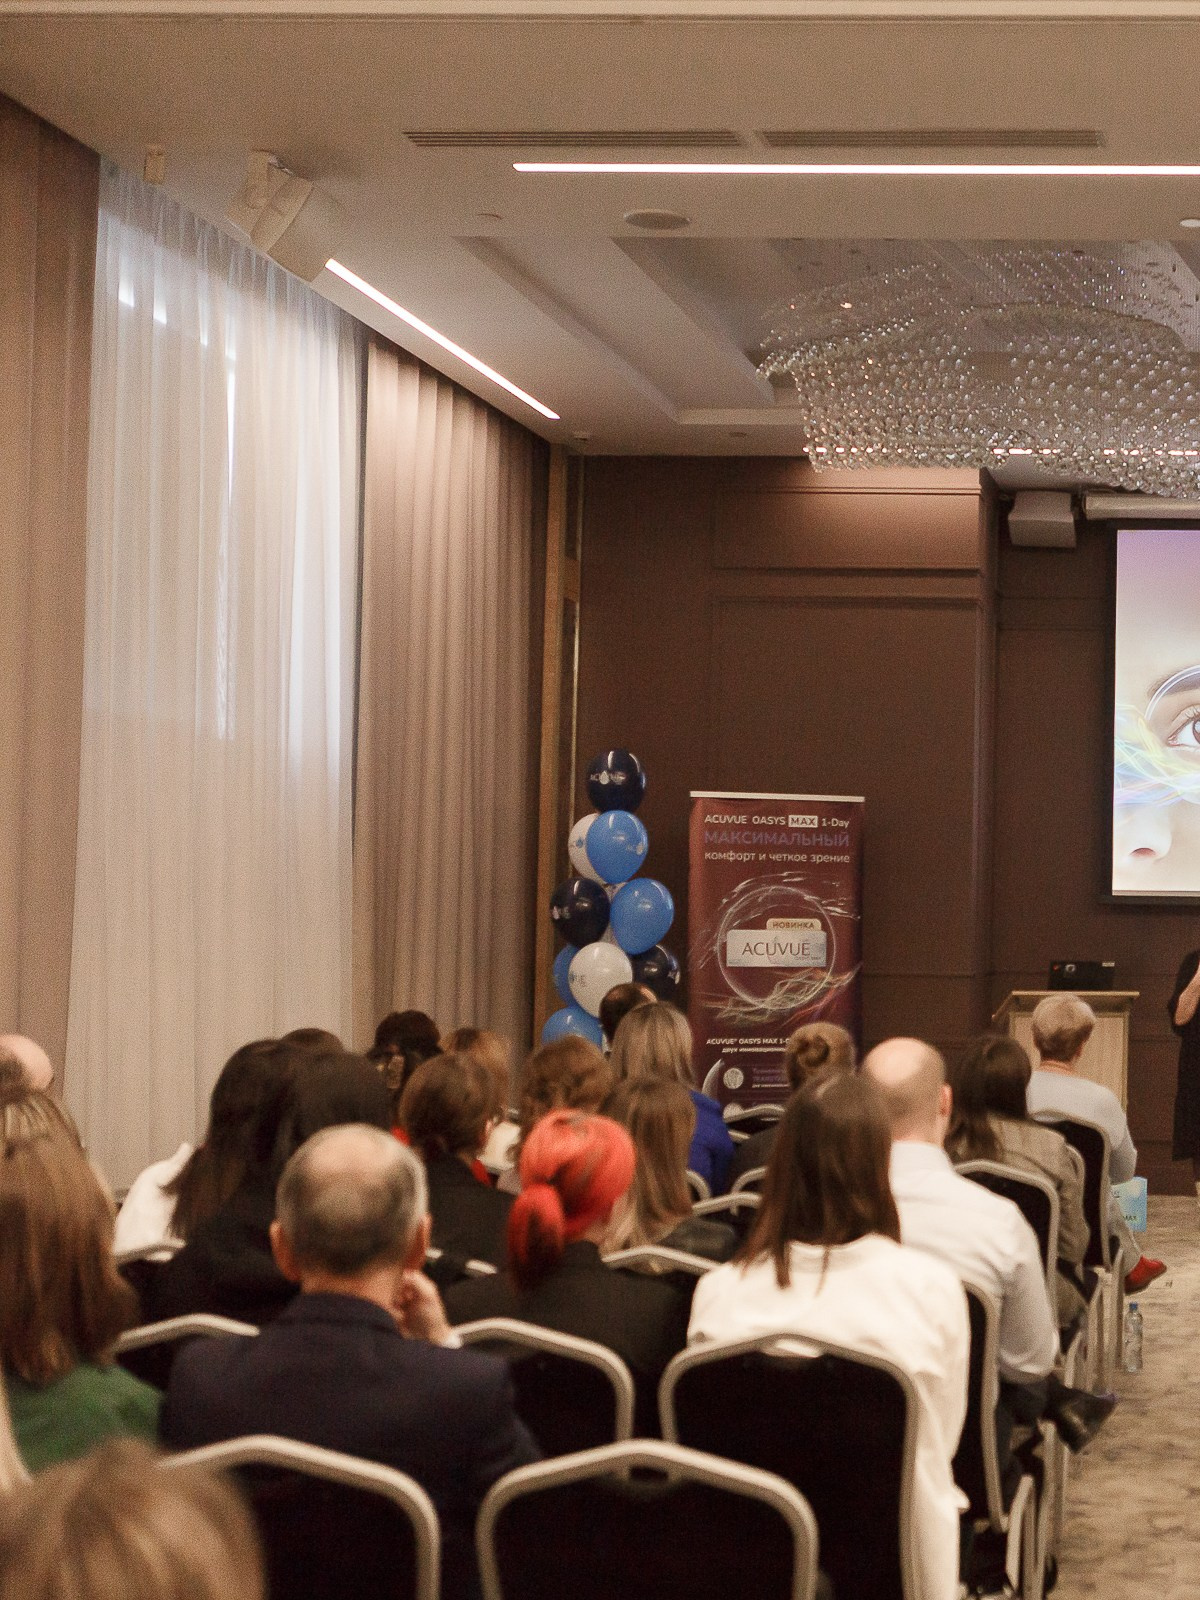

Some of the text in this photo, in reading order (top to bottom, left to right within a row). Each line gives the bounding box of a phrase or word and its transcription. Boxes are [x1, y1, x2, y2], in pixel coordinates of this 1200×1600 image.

[704, 814, 850, 828] ACUVUE OASYS MAX 1-Day
[704, 830, 850, 847] МАКСИМАЛЬНЫЙ
[704, 851, 850, 864] комфорт и четкое зрение
[772, 921, 815, 929] НОВИНКА
[741, 942, 811, 956] ACUVUE
